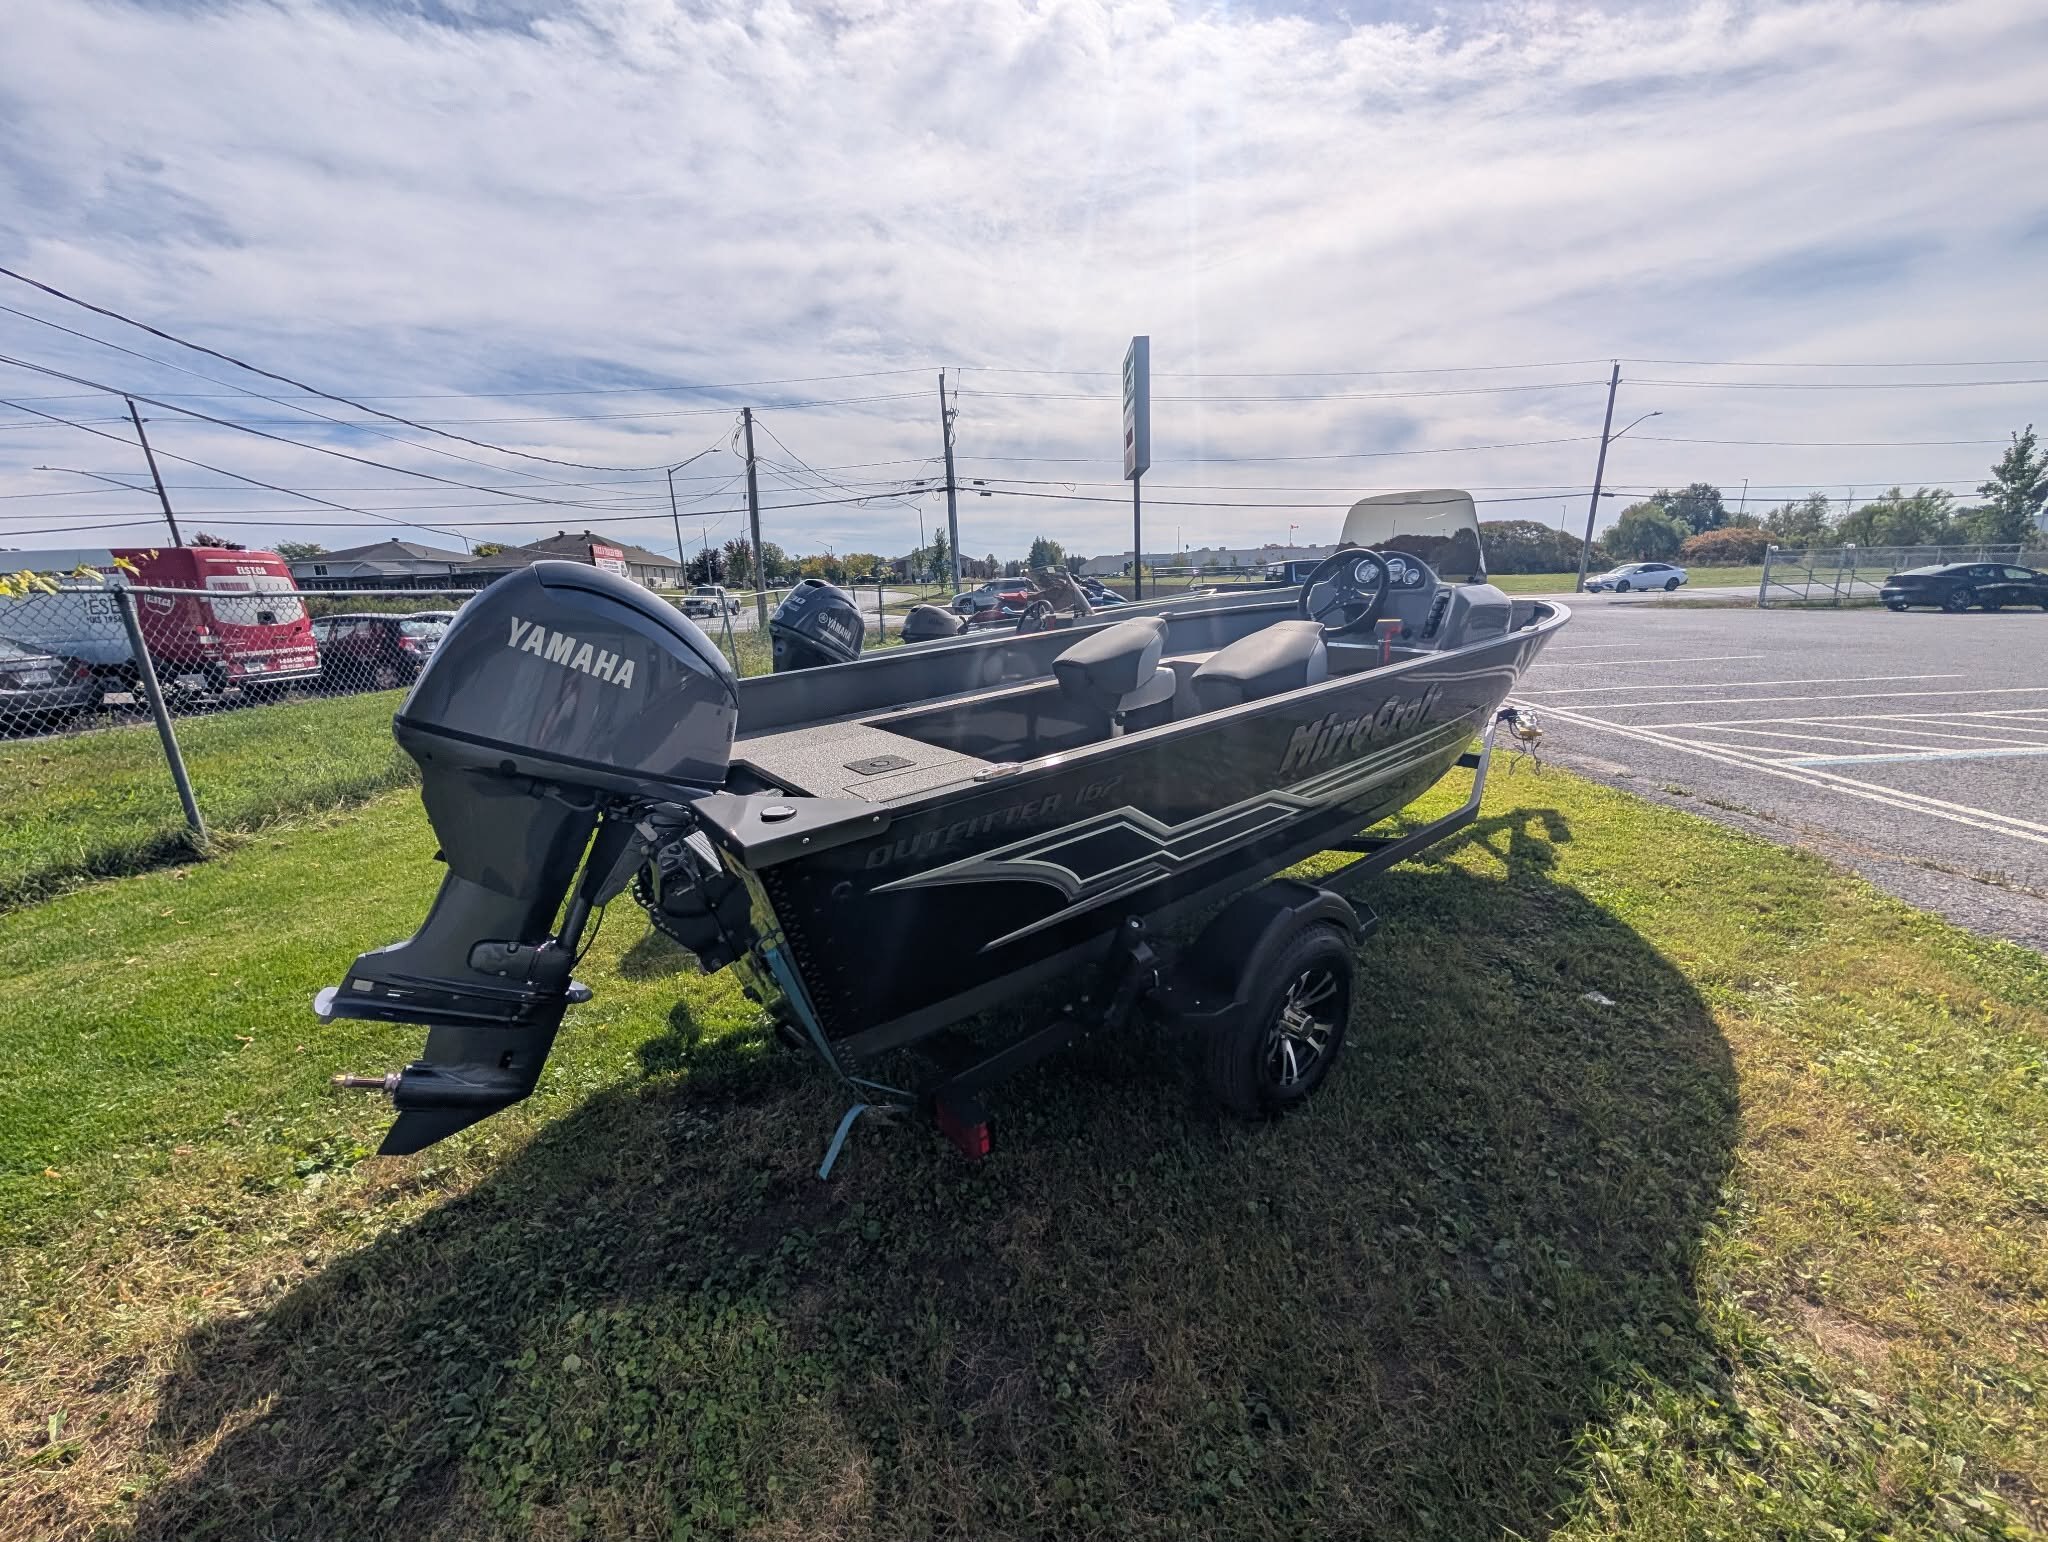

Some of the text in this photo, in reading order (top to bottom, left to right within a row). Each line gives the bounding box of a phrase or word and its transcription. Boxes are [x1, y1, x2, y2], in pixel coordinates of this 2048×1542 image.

[507, 616, 636, 689] YAMAHA
[826, 616, 853, 641] YAMAHA
[864, 793, 1062, 870] OUTFITTER
